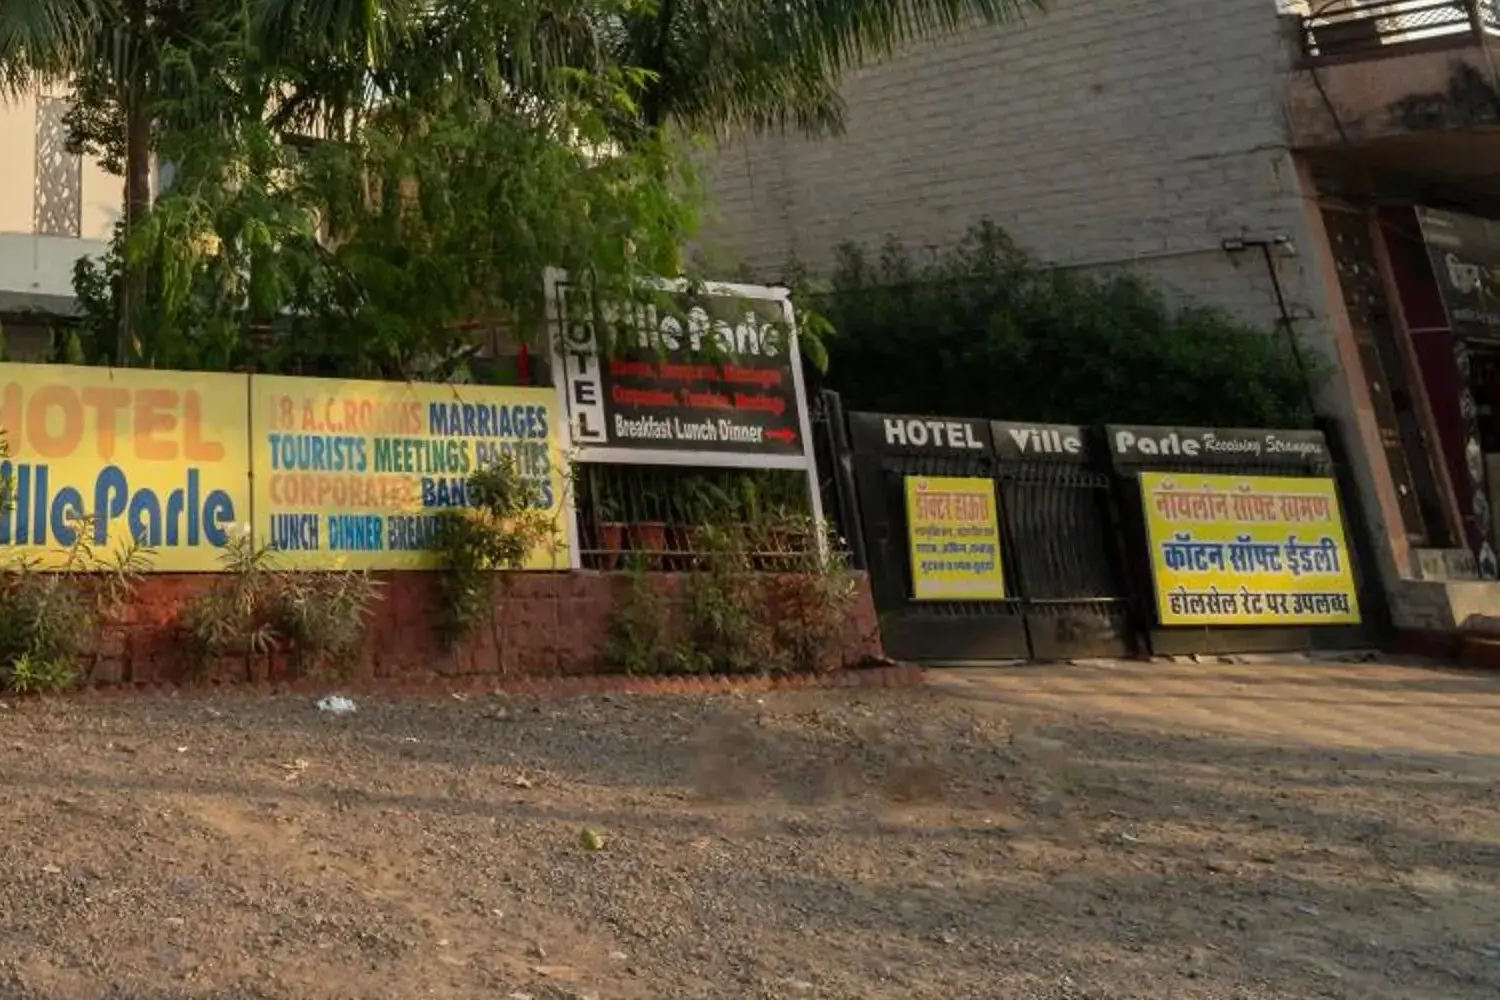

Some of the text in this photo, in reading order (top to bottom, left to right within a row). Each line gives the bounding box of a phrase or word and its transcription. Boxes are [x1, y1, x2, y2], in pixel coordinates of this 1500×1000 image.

[429, 402, 549, 439] MARRIAGES
[614, 413, 764, 444] Breakfast Lunch Dinner
[883, 418, 983, 449] HOTEL
[1009, 429, 1082, 454] Ville
[1116, 431, 1200, 457] Parle
[268, 433, 367, 472] TOURISTS
[373, 437, 471, 474] MEETINGS
[94, 464, 236, 549] Parle
[270, 513, 319, 551] LUNCH
[329, 514, 383, 551] DINNER
[1162, 533, 1225, 571] कॉटन
[1239, 586, 1264, 614] रेट
[1266, 593, 1289, 615] पर
